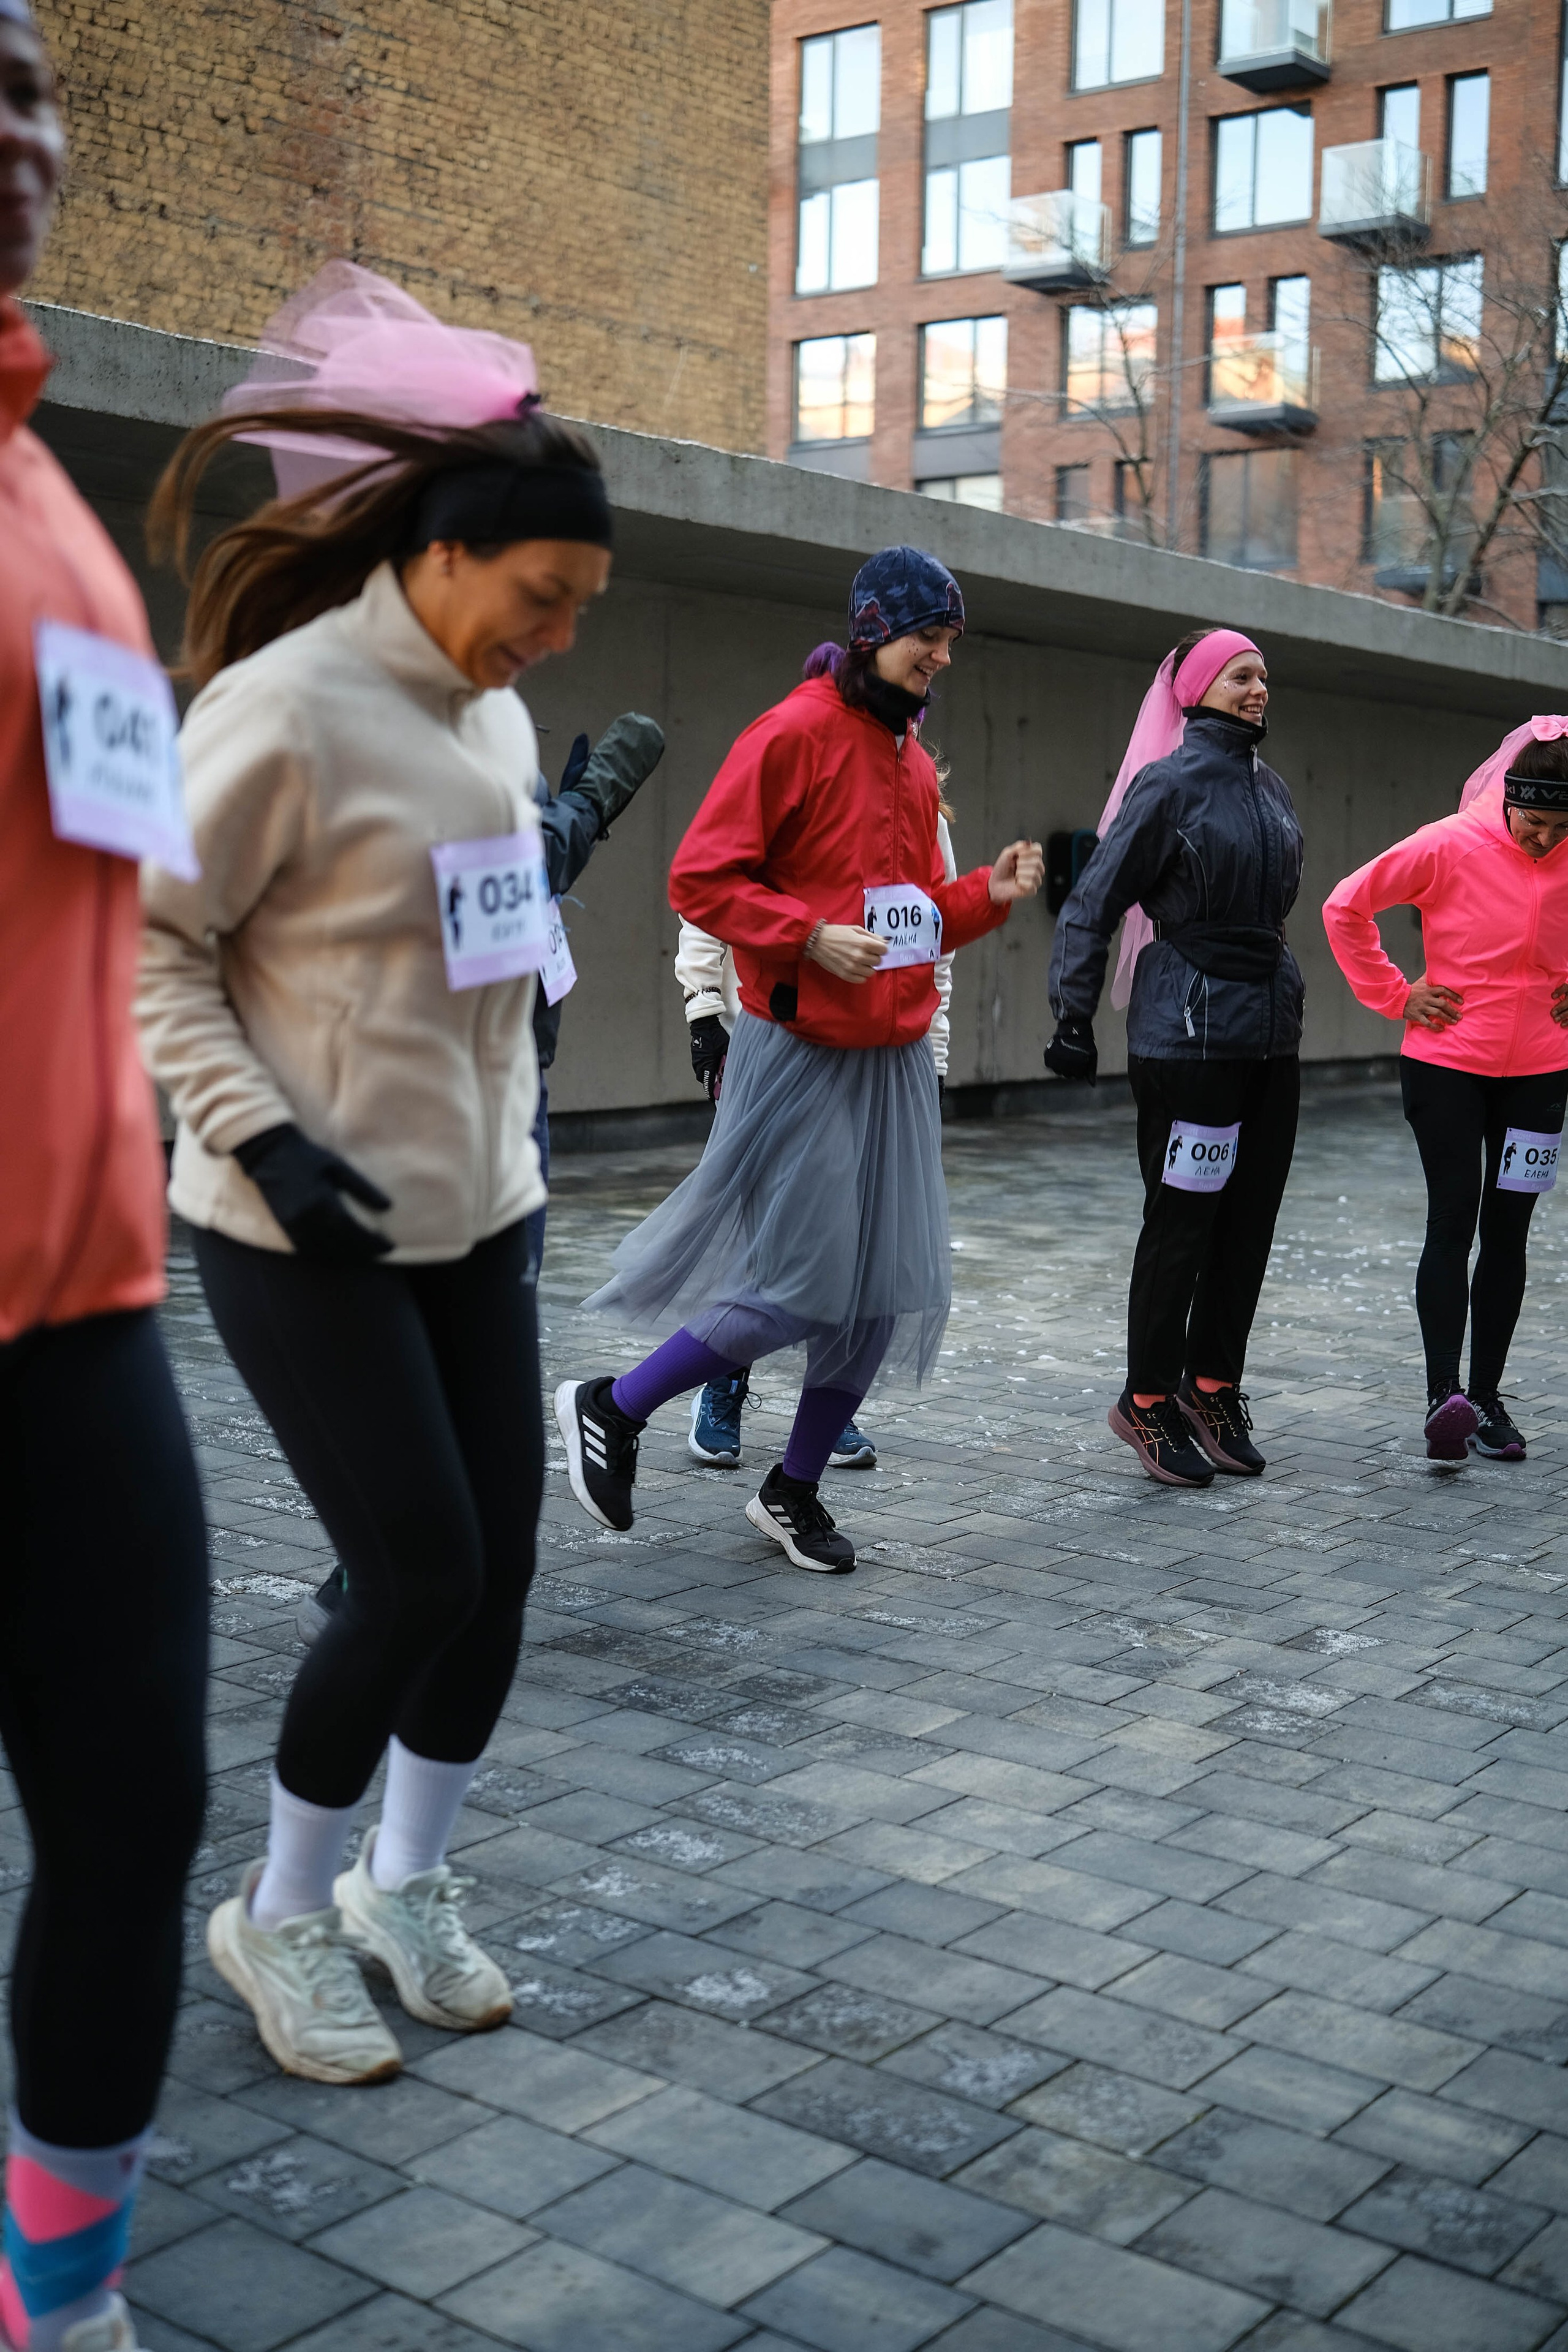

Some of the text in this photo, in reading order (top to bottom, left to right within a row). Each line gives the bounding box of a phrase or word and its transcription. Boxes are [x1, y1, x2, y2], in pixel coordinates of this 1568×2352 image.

[886, 905, 922, 930] 016
[1191, 1143, 1230, 1162] 006
[1525, 1147, 1558, 1166] 035
